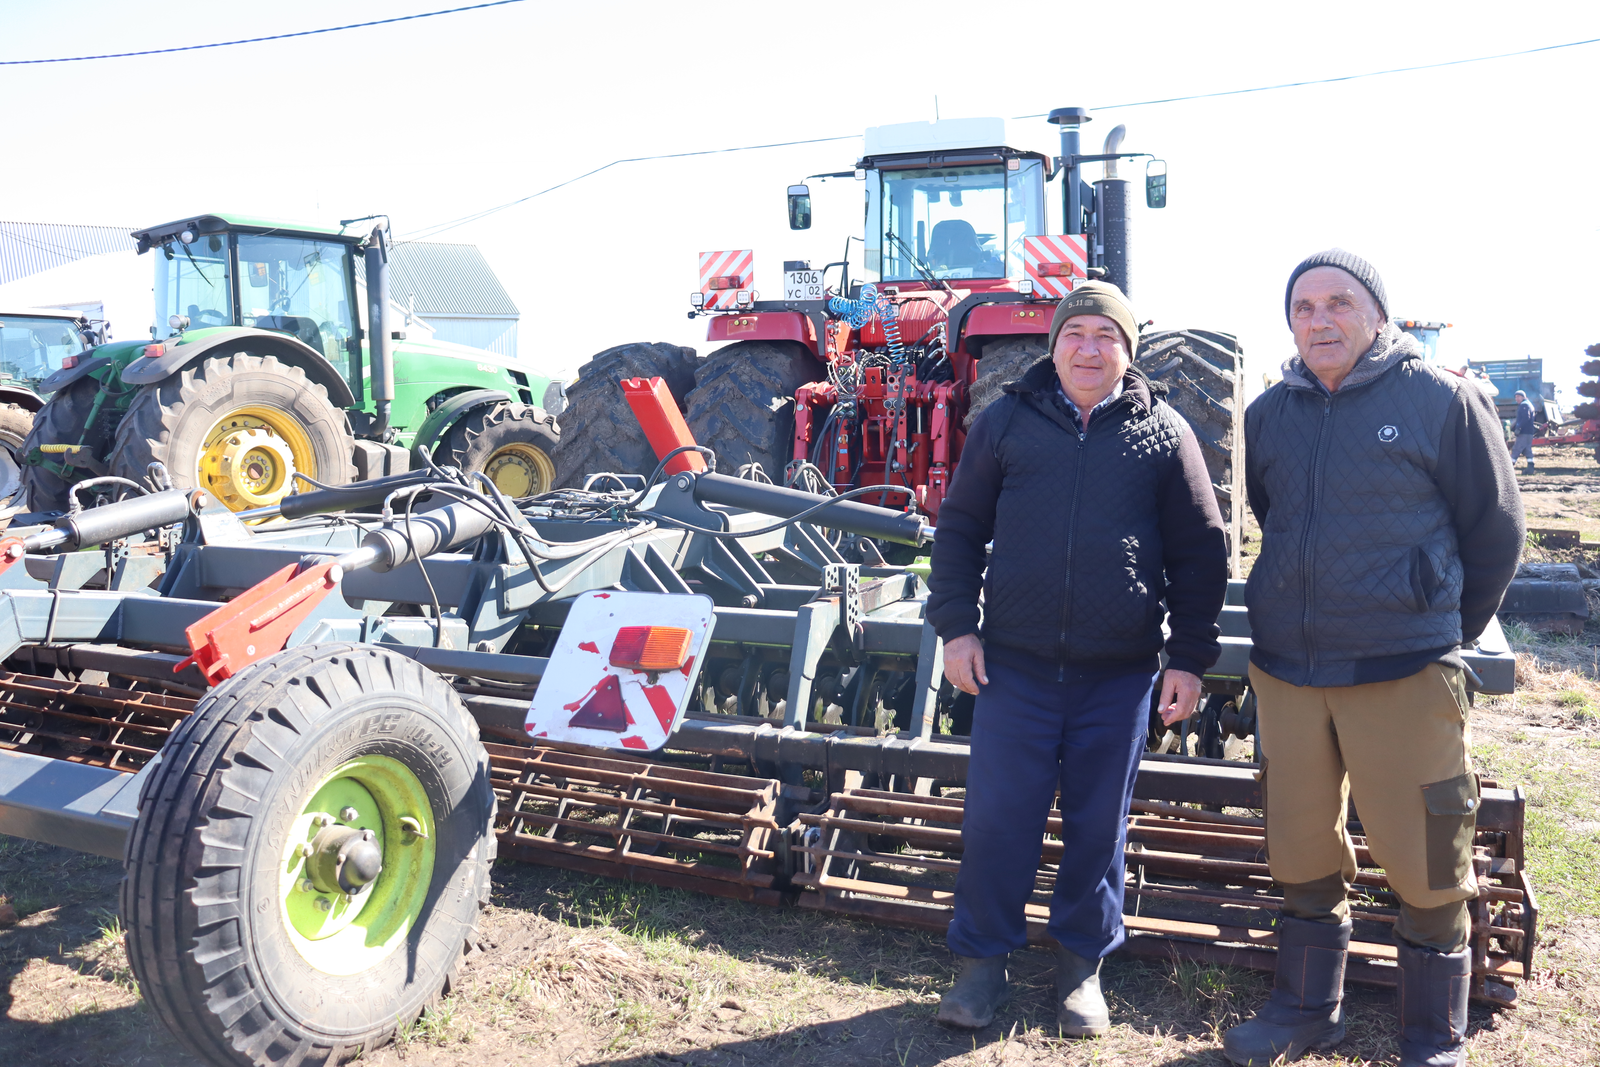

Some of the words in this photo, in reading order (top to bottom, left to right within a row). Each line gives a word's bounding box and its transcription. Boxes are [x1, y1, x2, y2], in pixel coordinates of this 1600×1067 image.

[790, 272, 818, 284] 1306
[788, 289, 801, 298] УС
[809, 286, 820, 295] 02
[1068, 300, 1083, 308] 5.11
[477, 364, 498, 375] 8430
